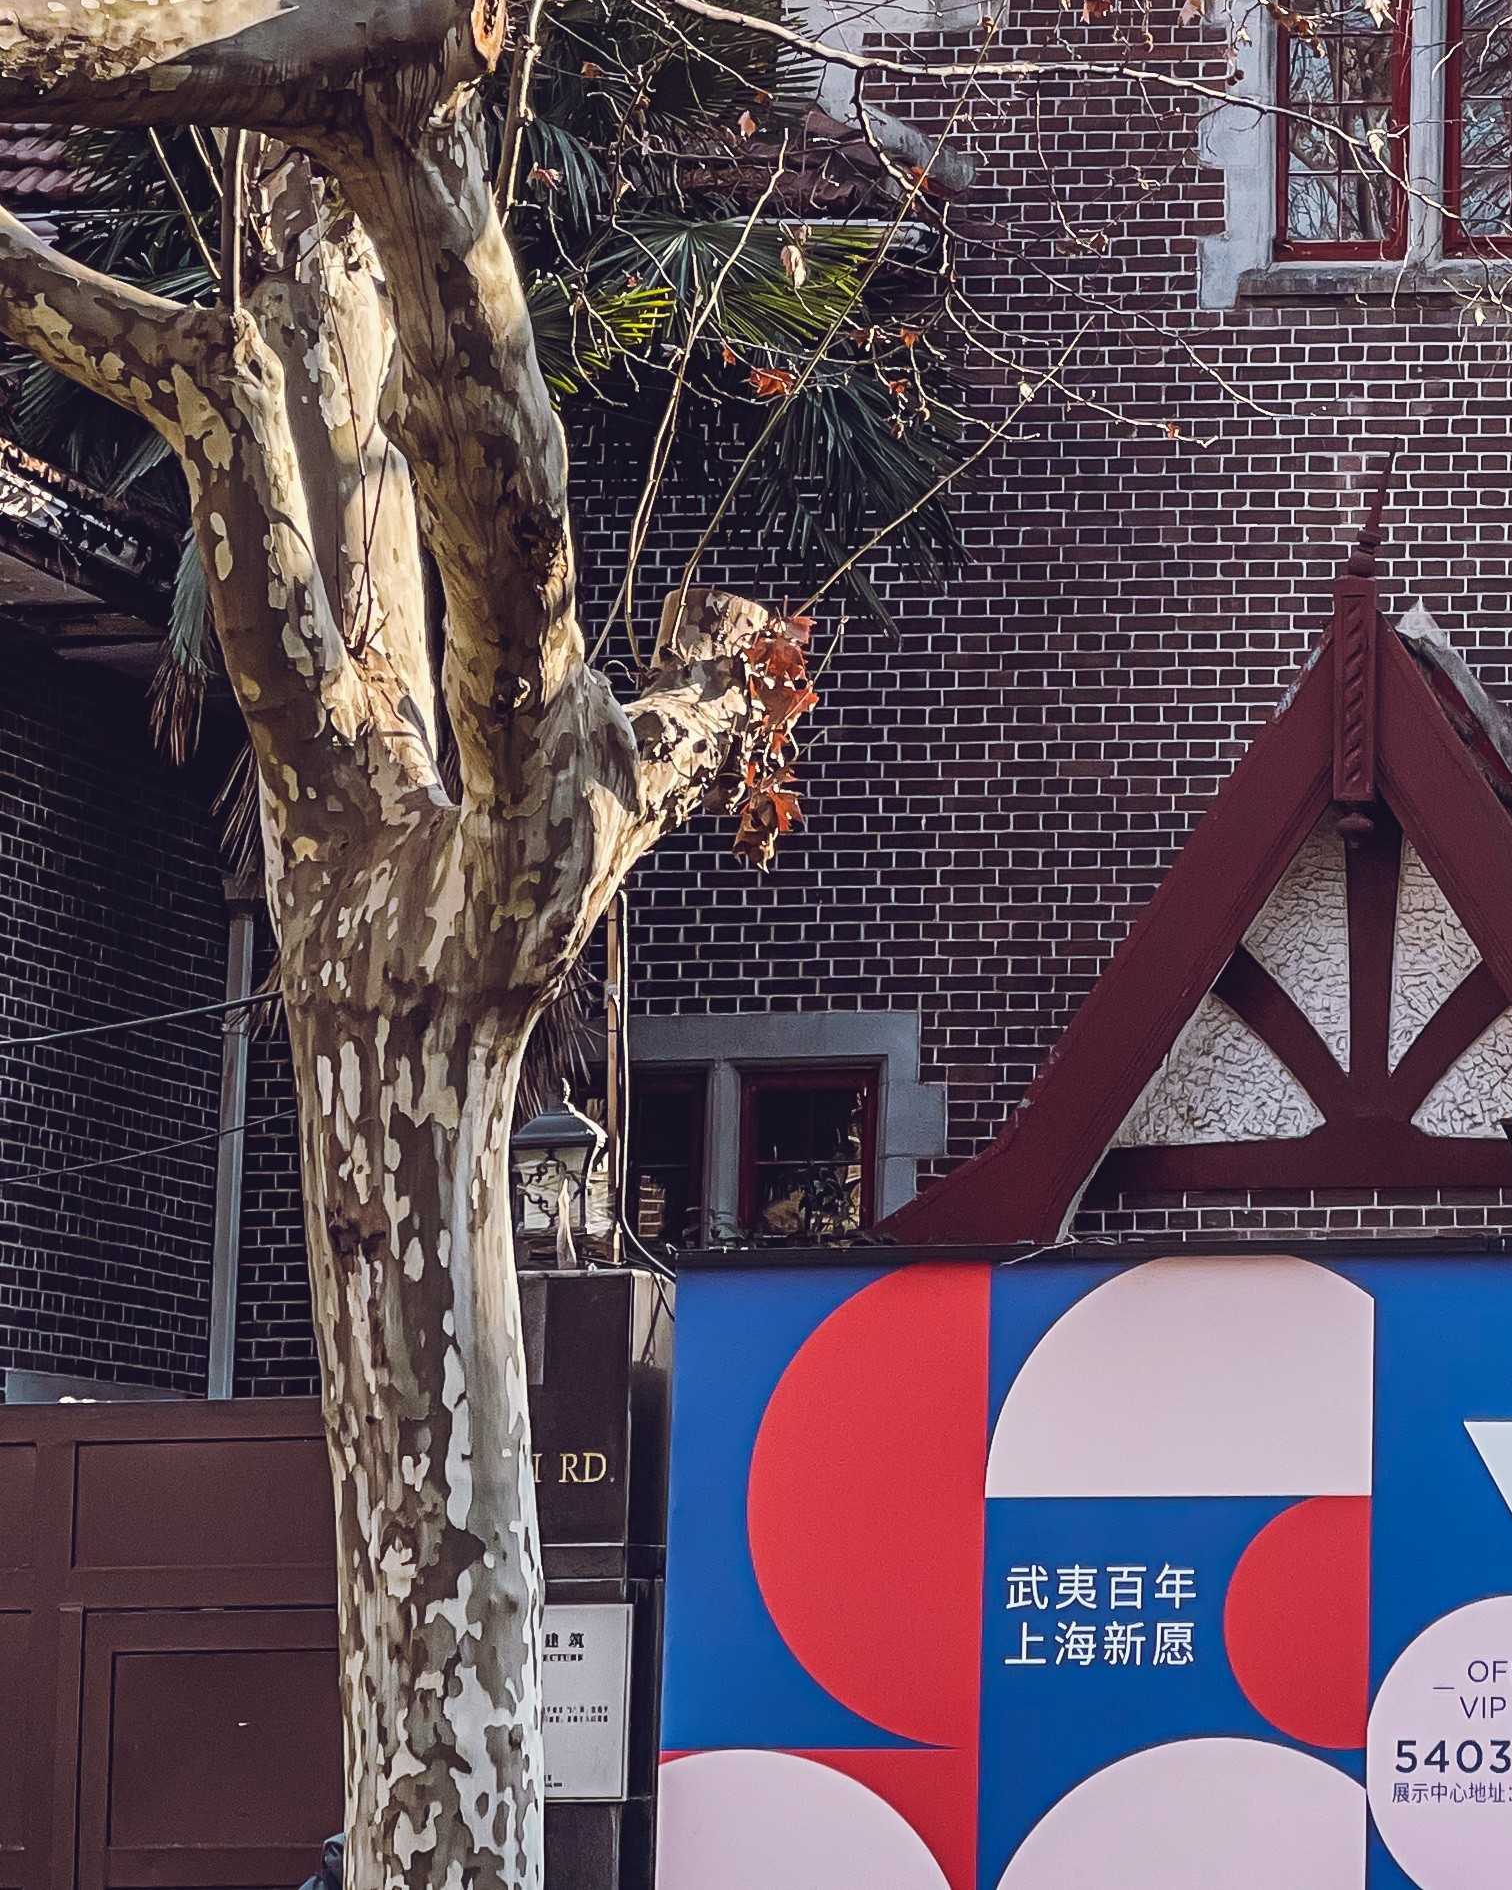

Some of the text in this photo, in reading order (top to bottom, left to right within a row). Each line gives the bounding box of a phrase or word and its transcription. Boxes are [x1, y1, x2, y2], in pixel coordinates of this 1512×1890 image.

[558, 1452, 615, 1483] RD.
[1005, 1563, 1197, 1610] 武夷百年
[1004, 1620, 1195, 1666] 上海新愿
[1459, 1696, 1507, 1719] VIP
[1395, 1739, 1512, 1774] 5403
